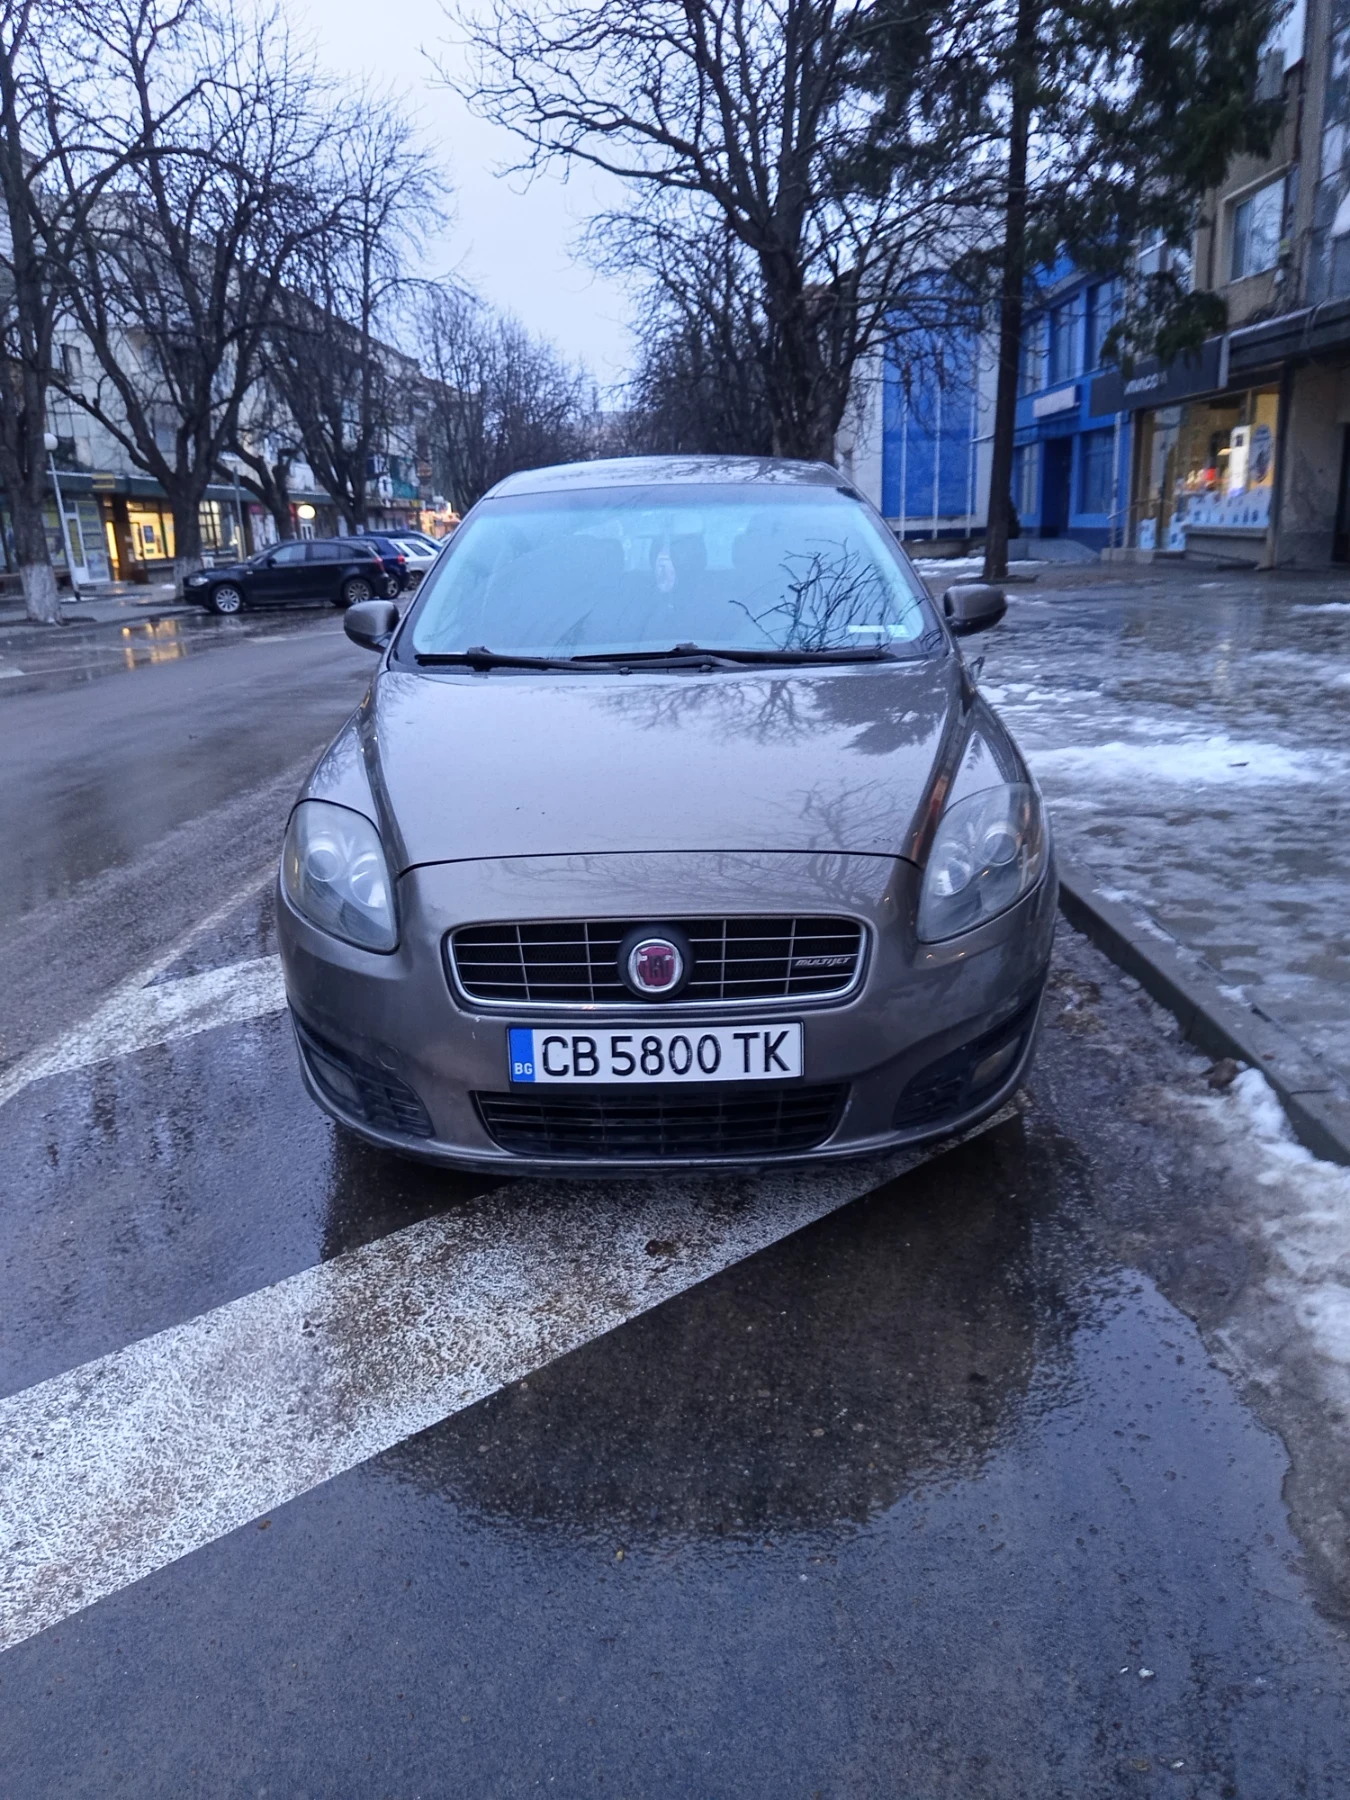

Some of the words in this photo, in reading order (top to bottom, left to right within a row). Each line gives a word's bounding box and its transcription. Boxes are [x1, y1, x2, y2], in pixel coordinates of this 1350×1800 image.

[795, 956, 851, 967] MULTIJET
[542, 1035, 600, 1077] CB
[610, 1034, 722, 1076] 5800
[733, 1030, 791, 1073] TK
[514, 1062, 533, 1075] BG
